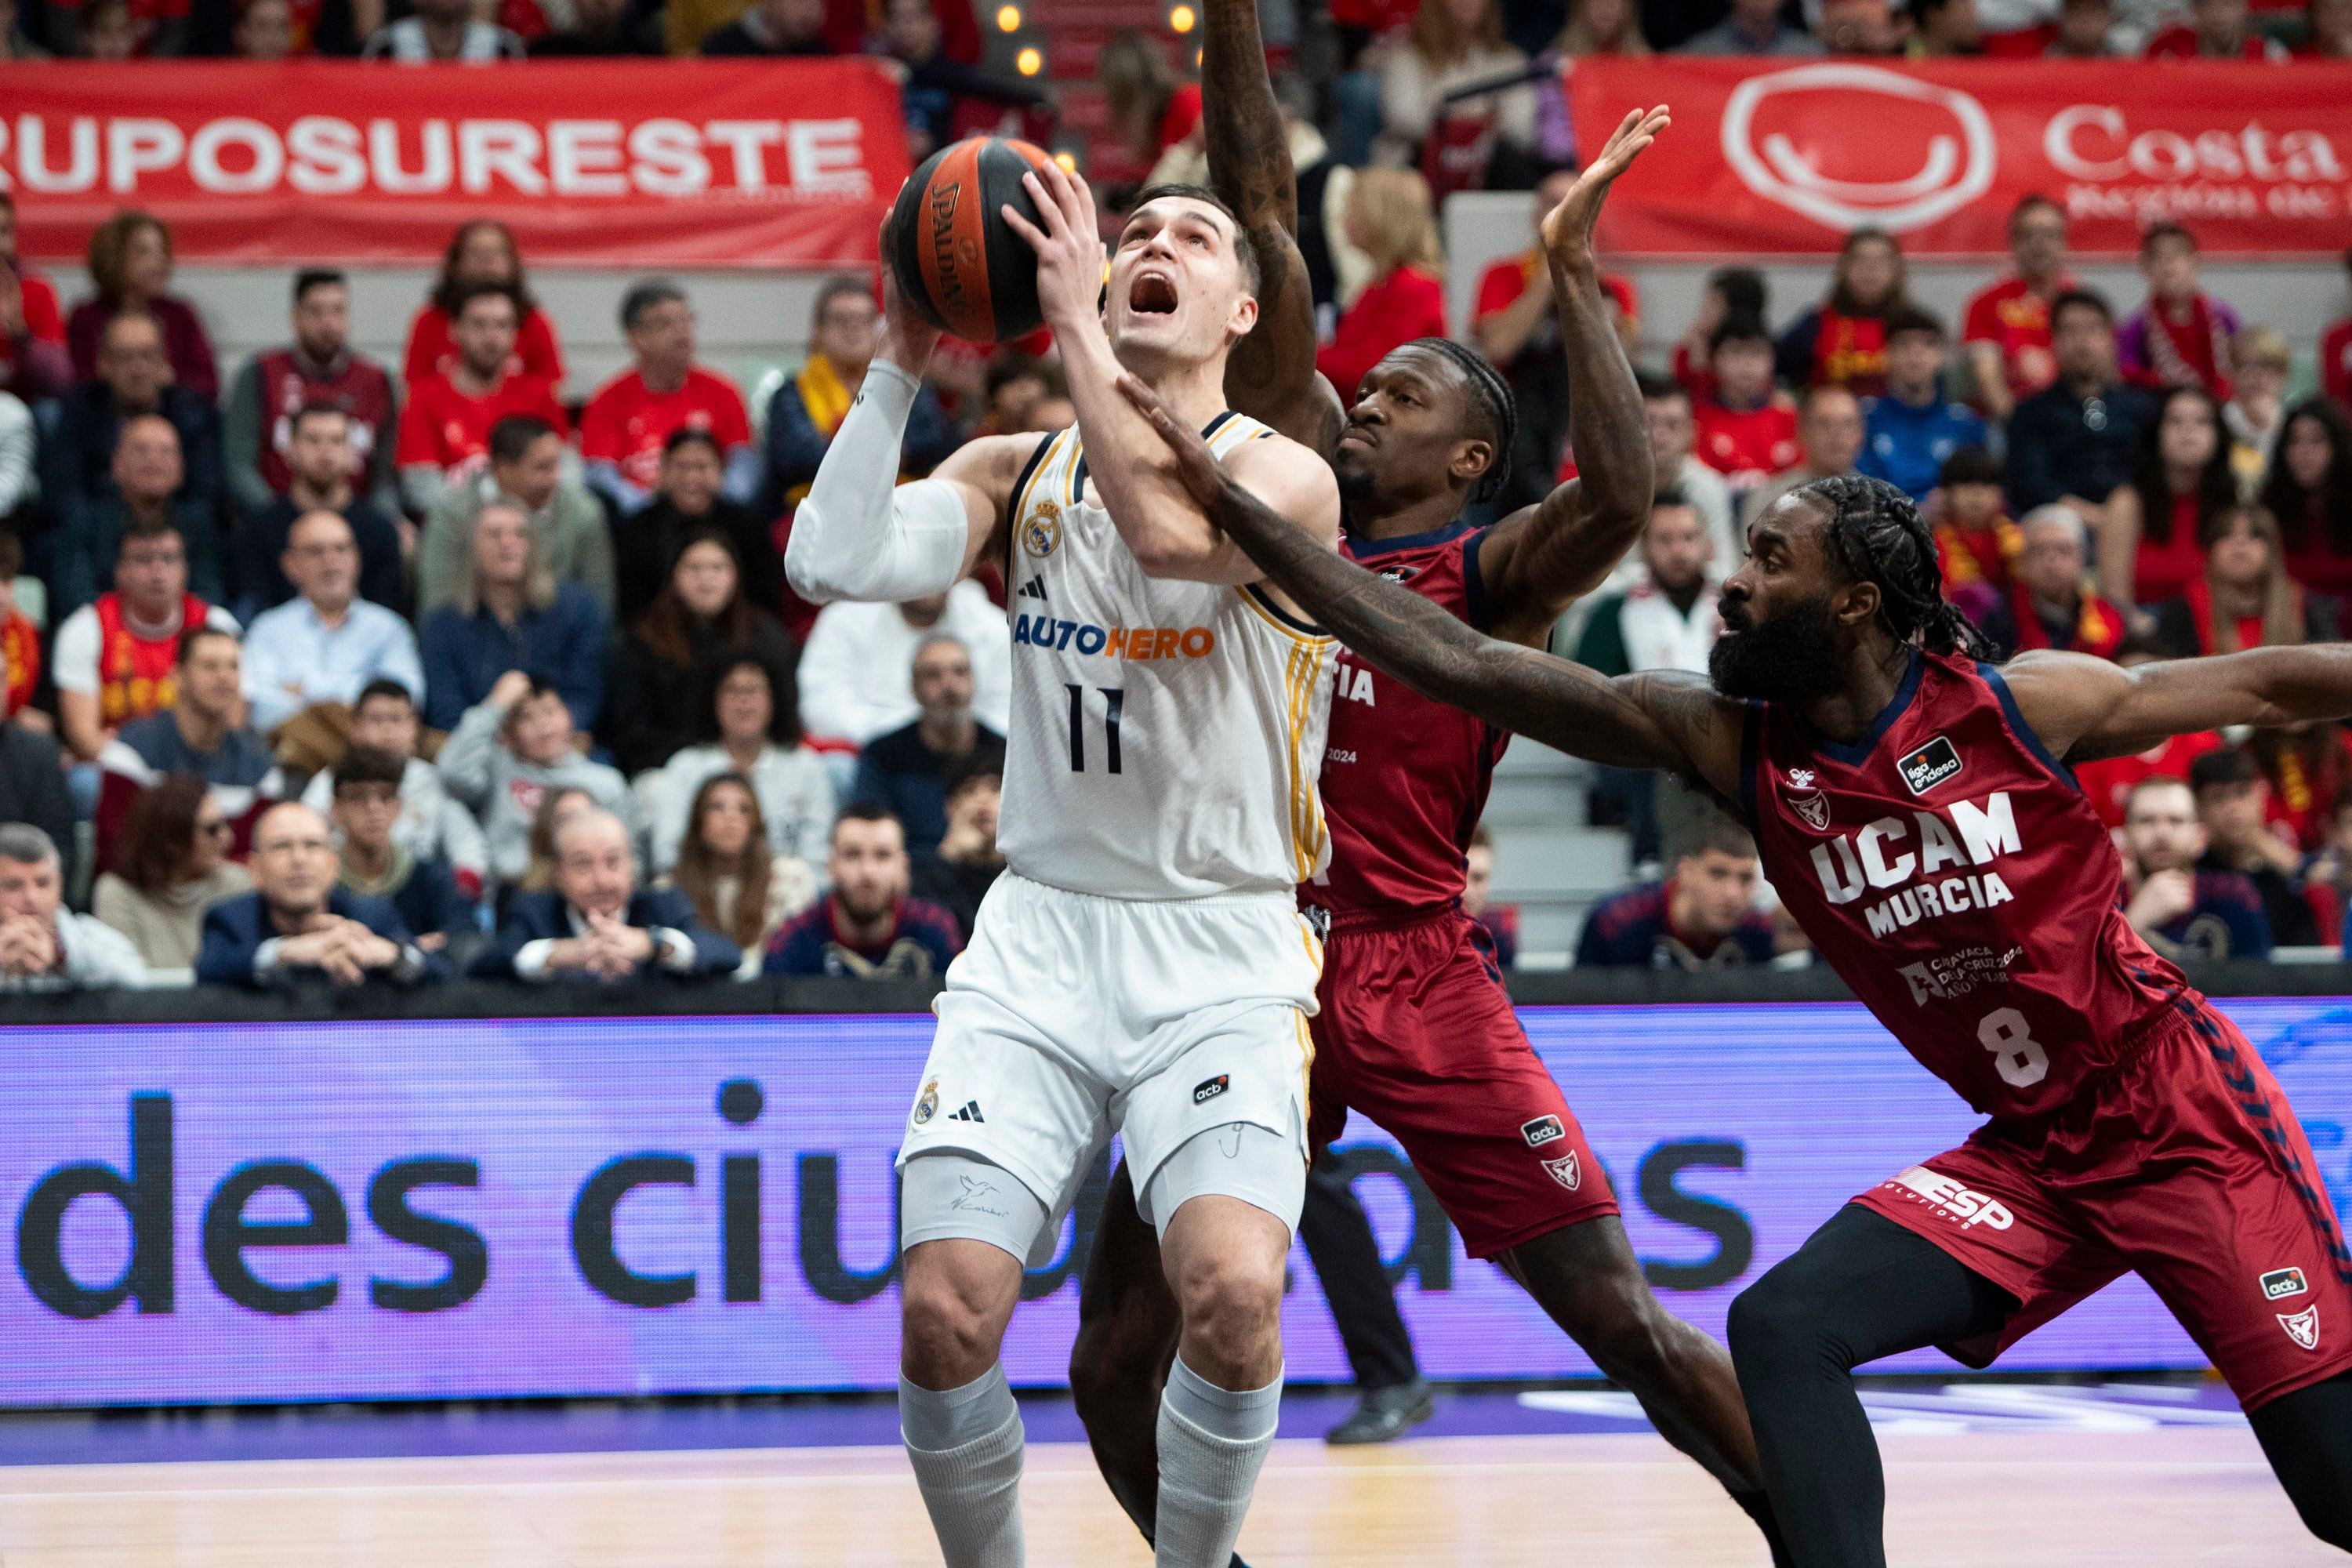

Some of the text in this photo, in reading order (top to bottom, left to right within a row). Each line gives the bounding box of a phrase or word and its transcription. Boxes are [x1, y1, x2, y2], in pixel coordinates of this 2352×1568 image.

[0, 116, 864, 198] UPOSURESTE
[2044, 103, 2349, 183] Costa
[1014, 614, 1215, 660] AUTOHERO
[1331, 663, 1375, 706] IA
[1064, 683, 1124, 775] 11
[1327, 747, 1357, 763] 2024
[1907, 761, 1930, 781] liga
[1914, 758, 1958, 789] endesa
[1809, 792, 2023, 905] UCAM
[1864, 872, 2015, 939] MURCIA
[1996, 946, 2024, 968] 2024
[1976, 1007, 2049, 1088] 8
[1196, 1083, 1221, 1100] acb
[1530, 1126, 1556, 1142] acb
[17, 1077, 1756, 1318] des cius
[1911, 1168, 2014, 1230] ESP
[2269, 1279, 2298, 1295] acb
